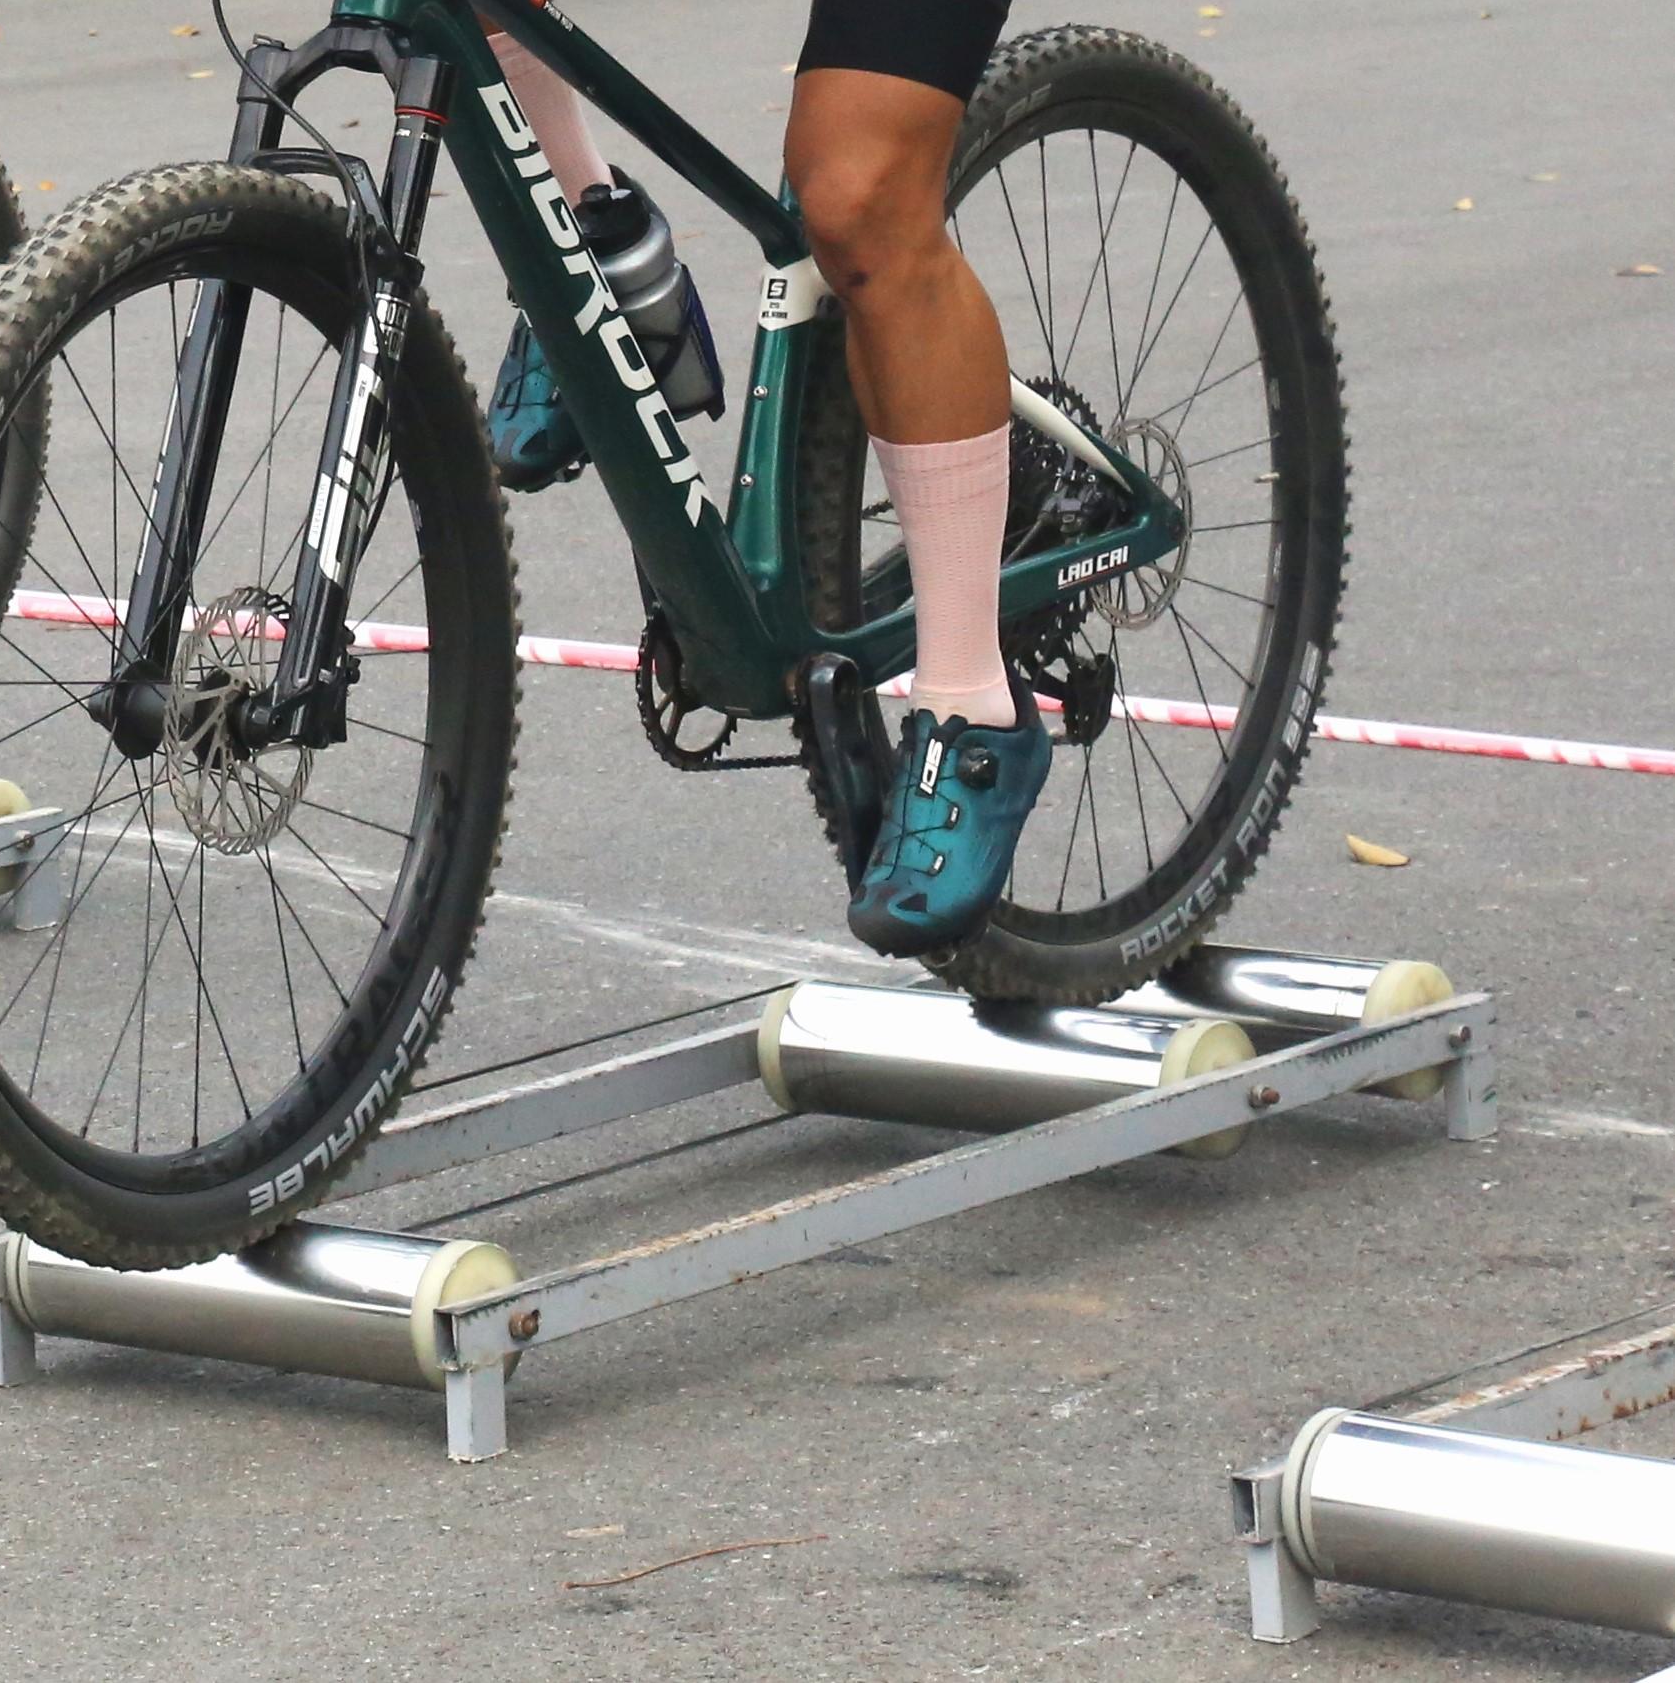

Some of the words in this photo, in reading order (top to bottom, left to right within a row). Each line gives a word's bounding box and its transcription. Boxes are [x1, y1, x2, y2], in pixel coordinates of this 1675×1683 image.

[477, 81, 727, 528] BIGROCK
[1057, 559, 1094, 586] LAO
[1096, 544, 1130, 572] CAI
[919, 737, 944, 796] SIDI
[1119, 856, 1230, 967] ROCKET
[1235, 757, 1289, 857] RON
[247, 964, 450, 1218] SCHWALBE
